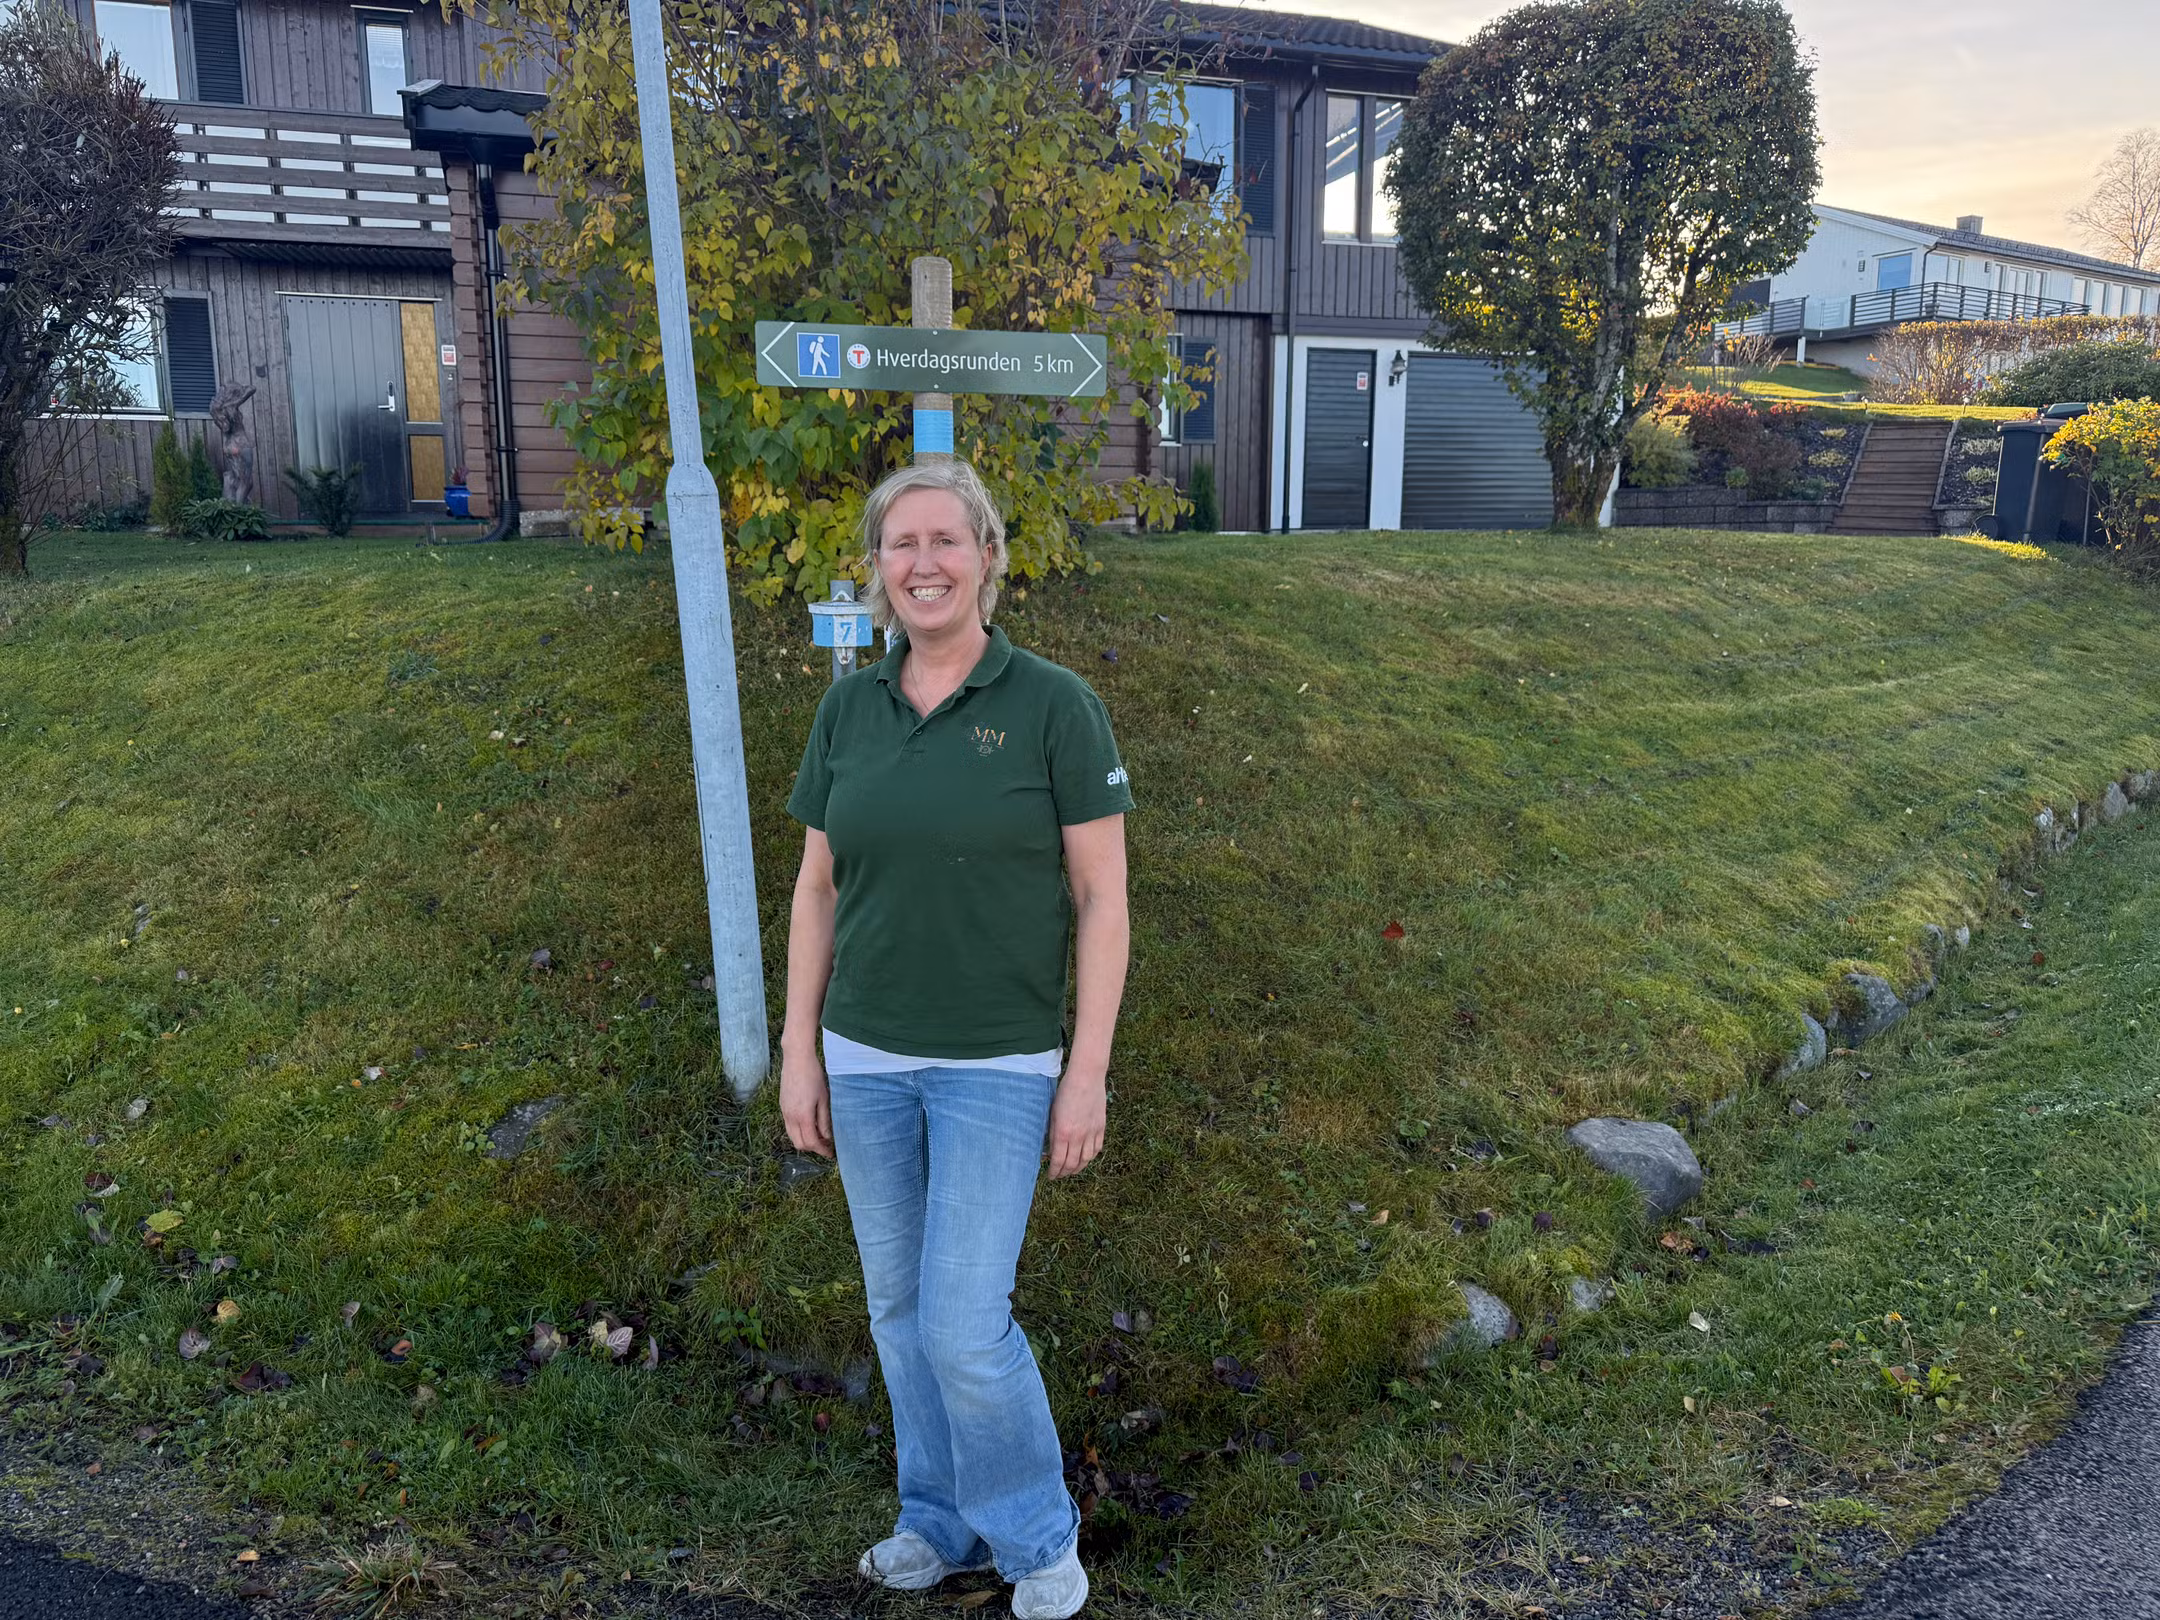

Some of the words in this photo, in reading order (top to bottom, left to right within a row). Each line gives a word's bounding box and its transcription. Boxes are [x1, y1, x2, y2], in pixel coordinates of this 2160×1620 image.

[877, 348, 1021, 374] Hverdagsrunden
[1033, 355, 1044, 373] 5
[1048, 353, 1074, 373] km
[840, 621, 852, 643] 7
